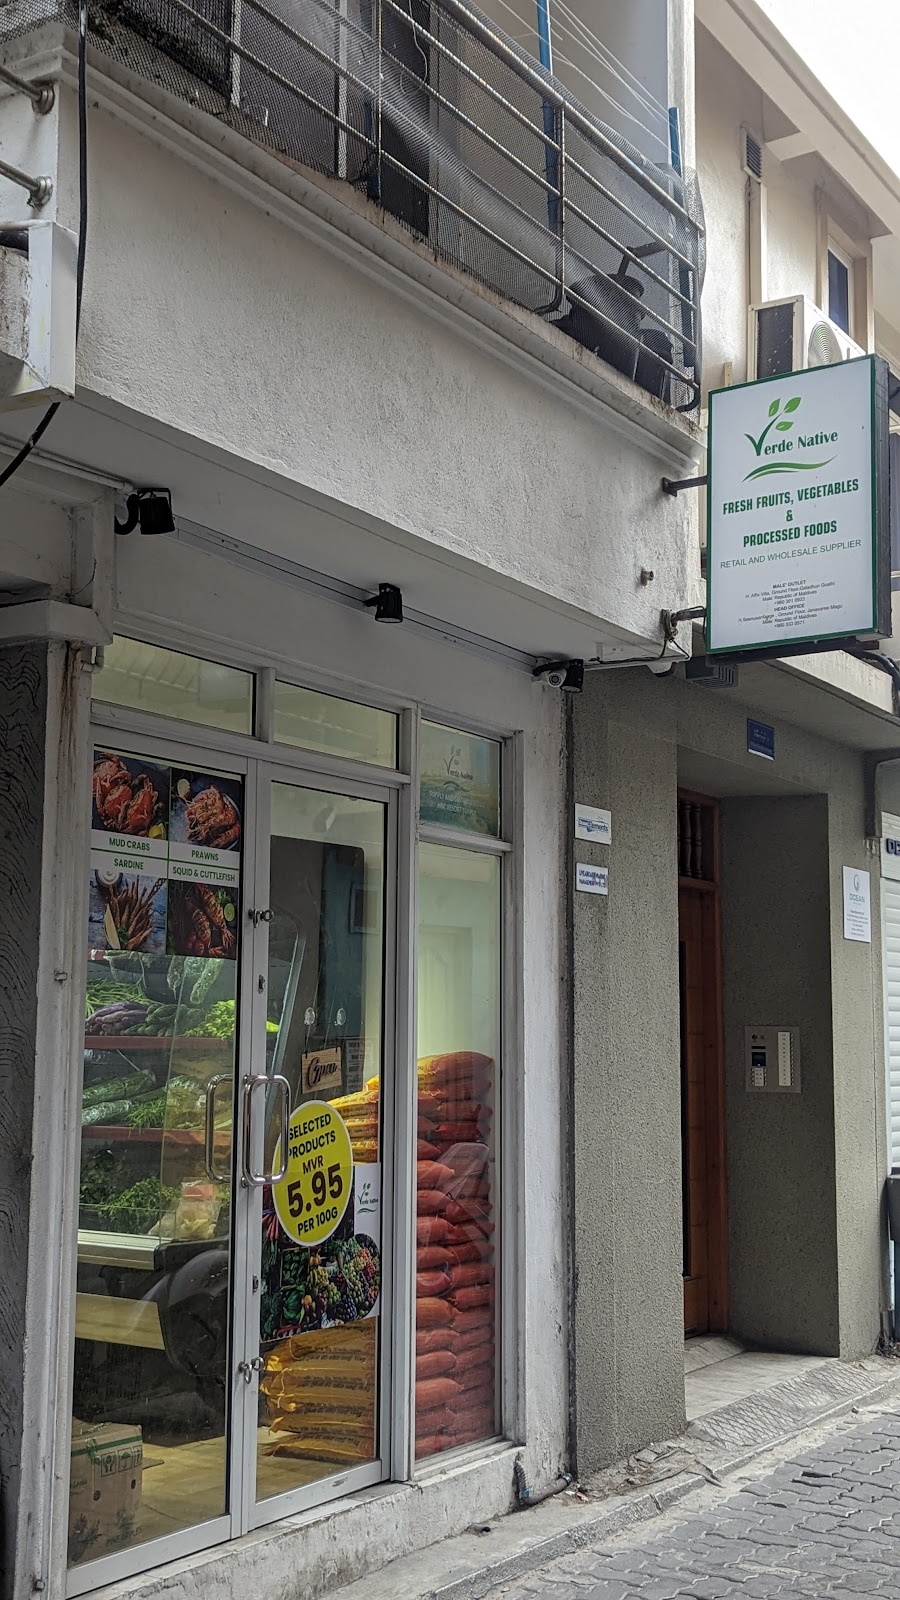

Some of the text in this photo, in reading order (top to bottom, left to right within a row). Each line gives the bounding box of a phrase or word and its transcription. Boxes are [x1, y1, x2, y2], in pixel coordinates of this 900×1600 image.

[744, 413, 838, 456] Verde Native
[722, 478, 859, 515] FRESH FRUITS, VEGETABLES
[786, 509, 793, 522] &
[743, 520, 837, 547] PROCESSED FOODS
[720, 539, 862, 569] RETAIL AND WHOLESALE SUPPLIER
[109, 838, 150, 851] MUD CRABS
[191, 850, 219, 861] PRAWNS
[114, 859, 144, 870] SARDINE
[172, 866, 235, 882] SQUID & CUTTLEFISH
[289, 1113, 332, 1141] SELECTED
[289, 1130, 336, 1159] RODUCTS
[302, 1155, 324, 1175] MVR
[287, 1163, 343, 1218] 5.95
[297, 1206, 338, 1236] PER 100G
